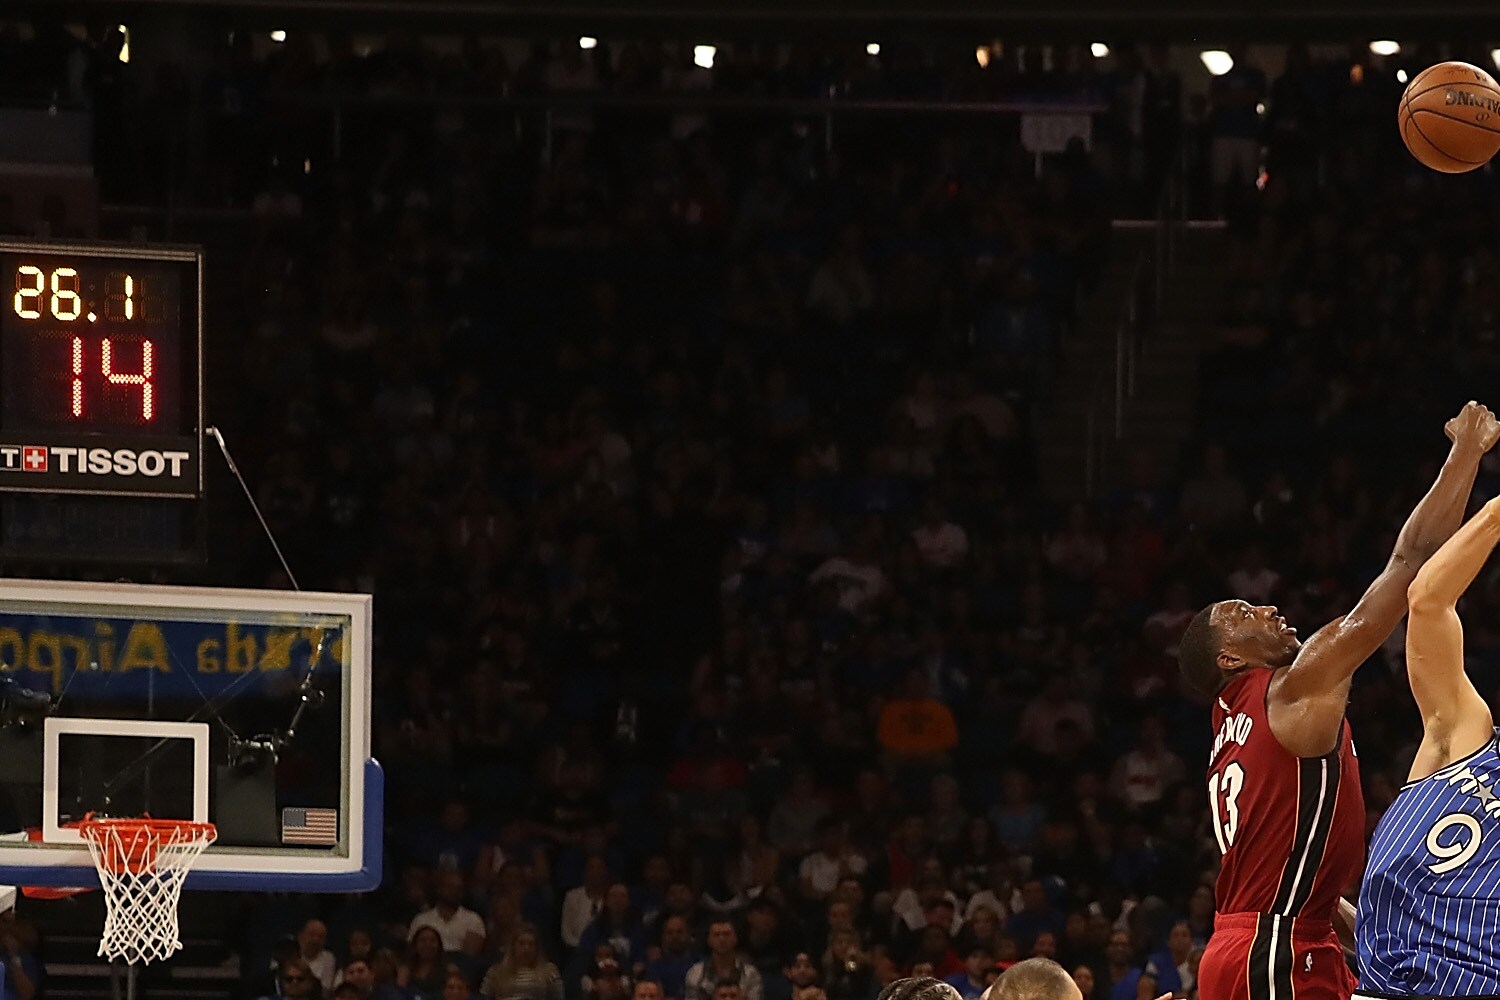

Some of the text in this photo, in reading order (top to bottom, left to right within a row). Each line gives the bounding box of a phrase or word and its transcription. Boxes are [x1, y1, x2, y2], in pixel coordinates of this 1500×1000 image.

[14, 265, 134, 323] 26.1
[72, 336, 153, 420] 14
[51, 446, 189, 478] TISSOT
[1208, 762, 1245, 855] 13
[1426, 812, 1482, 875] 9
